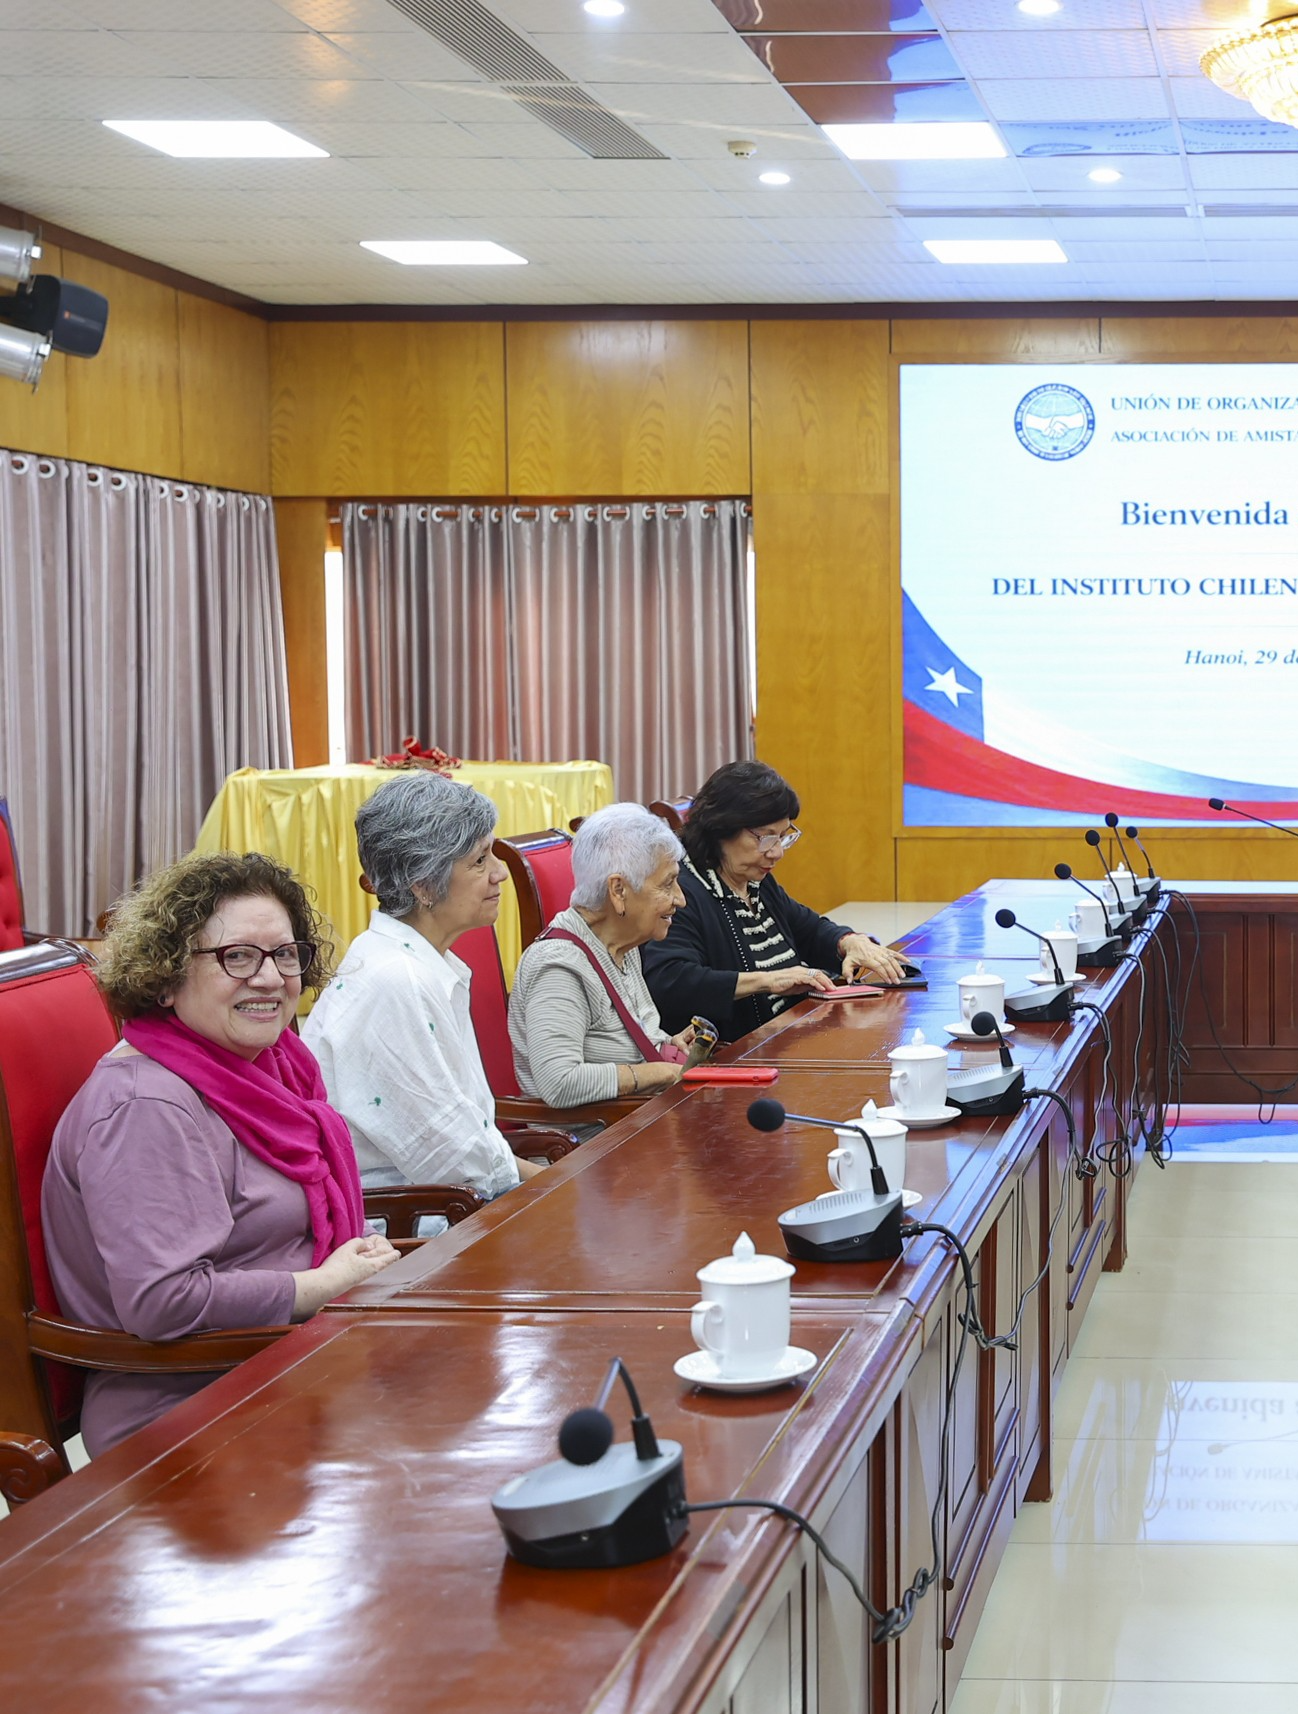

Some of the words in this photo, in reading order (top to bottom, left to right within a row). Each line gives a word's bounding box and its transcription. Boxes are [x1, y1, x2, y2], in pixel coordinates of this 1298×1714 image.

[1111, 393, 1171, 410] UNIÓN
[1178, 396, 1202, 410] DE
[1111, 428, 1210, 442] ASOCIACIÓN
[1217, 430, 1238, 442] DE
[1121, 500, 1289, 526] Bienvenida
[992, 577, 1043, 596] DEL
[1051, 577, 1191, 596] INSTITUTO
[1184, 649, 1249, 667] Hanoi,
[1254, 649, 1278, 665] 29
